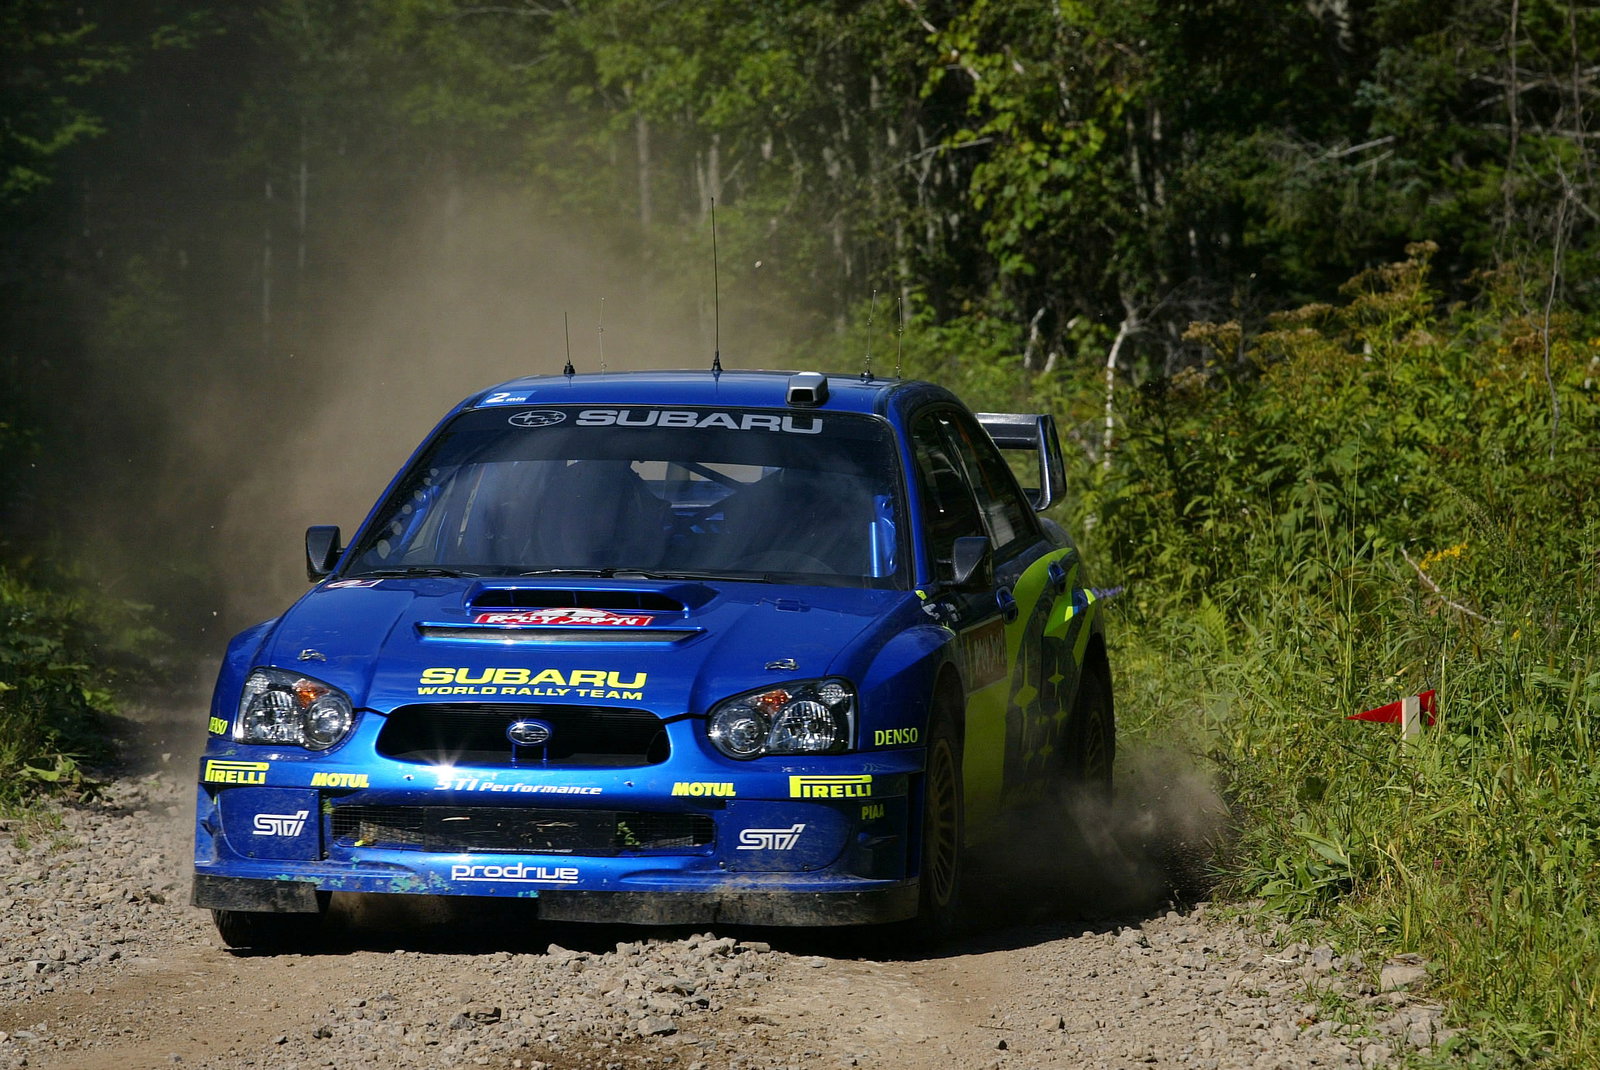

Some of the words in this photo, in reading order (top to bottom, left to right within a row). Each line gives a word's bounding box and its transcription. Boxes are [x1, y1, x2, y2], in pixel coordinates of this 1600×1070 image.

[486, 393, 511, 403] 2
[576, 409, 823, 435] SUBARU
[419, 668, 648, 689] SUBARU
[417, 687, 497, 695] WORLD
[501, 688, 571, 696] RALLY
[576, 689, 643, 701] TEAM
[874, 727, 919, 746] DENSO
[204, 760, 270, 784] PIRELLI
[311, 773, 370, 788] MOTUL
[434, 778, 479, 791] STI
[479, 782, 603, 795] Performance
[671, 782, 736, 797] MOTUL
[789, 775, 872, 798] PIRELLI
[861, 803, 885, 820] PIAA
[451, 862, 579, 884] prodrive
